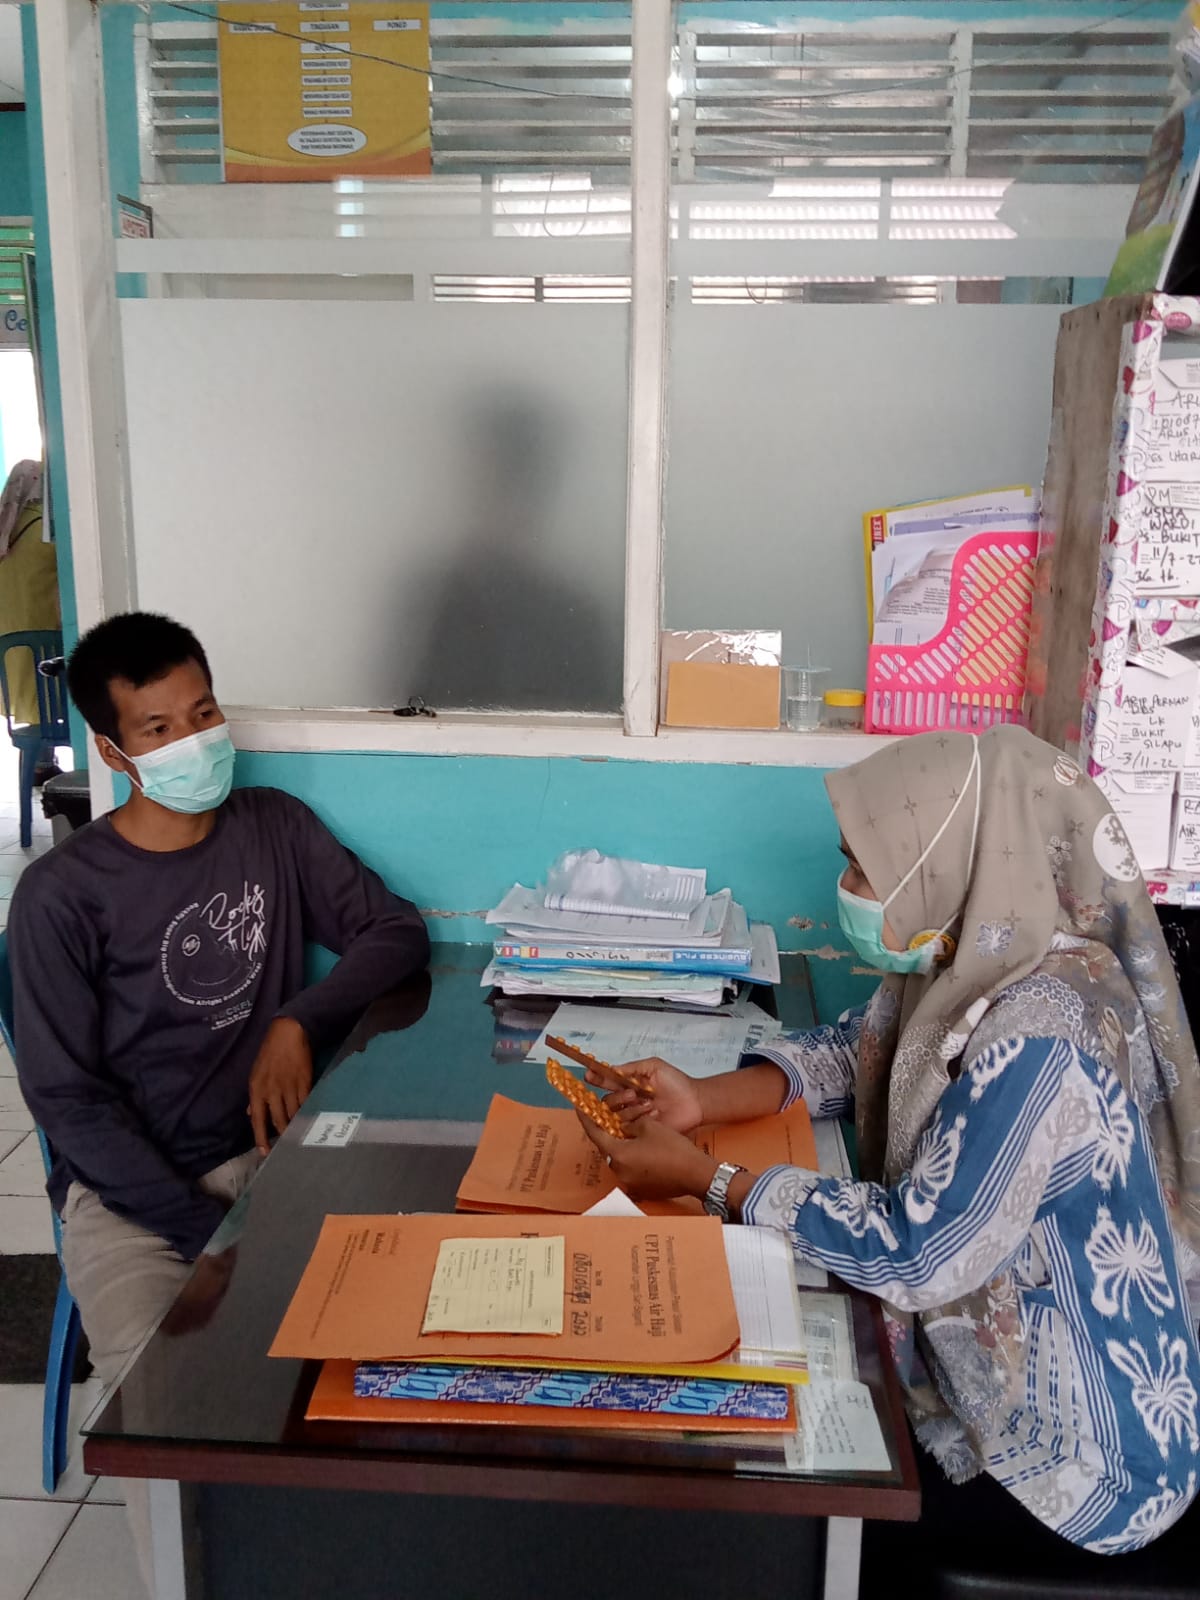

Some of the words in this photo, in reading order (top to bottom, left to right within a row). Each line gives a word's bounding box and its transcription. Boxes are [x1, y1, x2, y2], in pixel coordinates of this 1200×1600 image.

[675, 951, 697, 960] FILE
[645, 1234, 659, 1252] UPT
[645, 1256, 661, 1300] Puskesmas
[649, 1302, 664, 1317] Air
[648, 1318, 666, 1337] Haji
